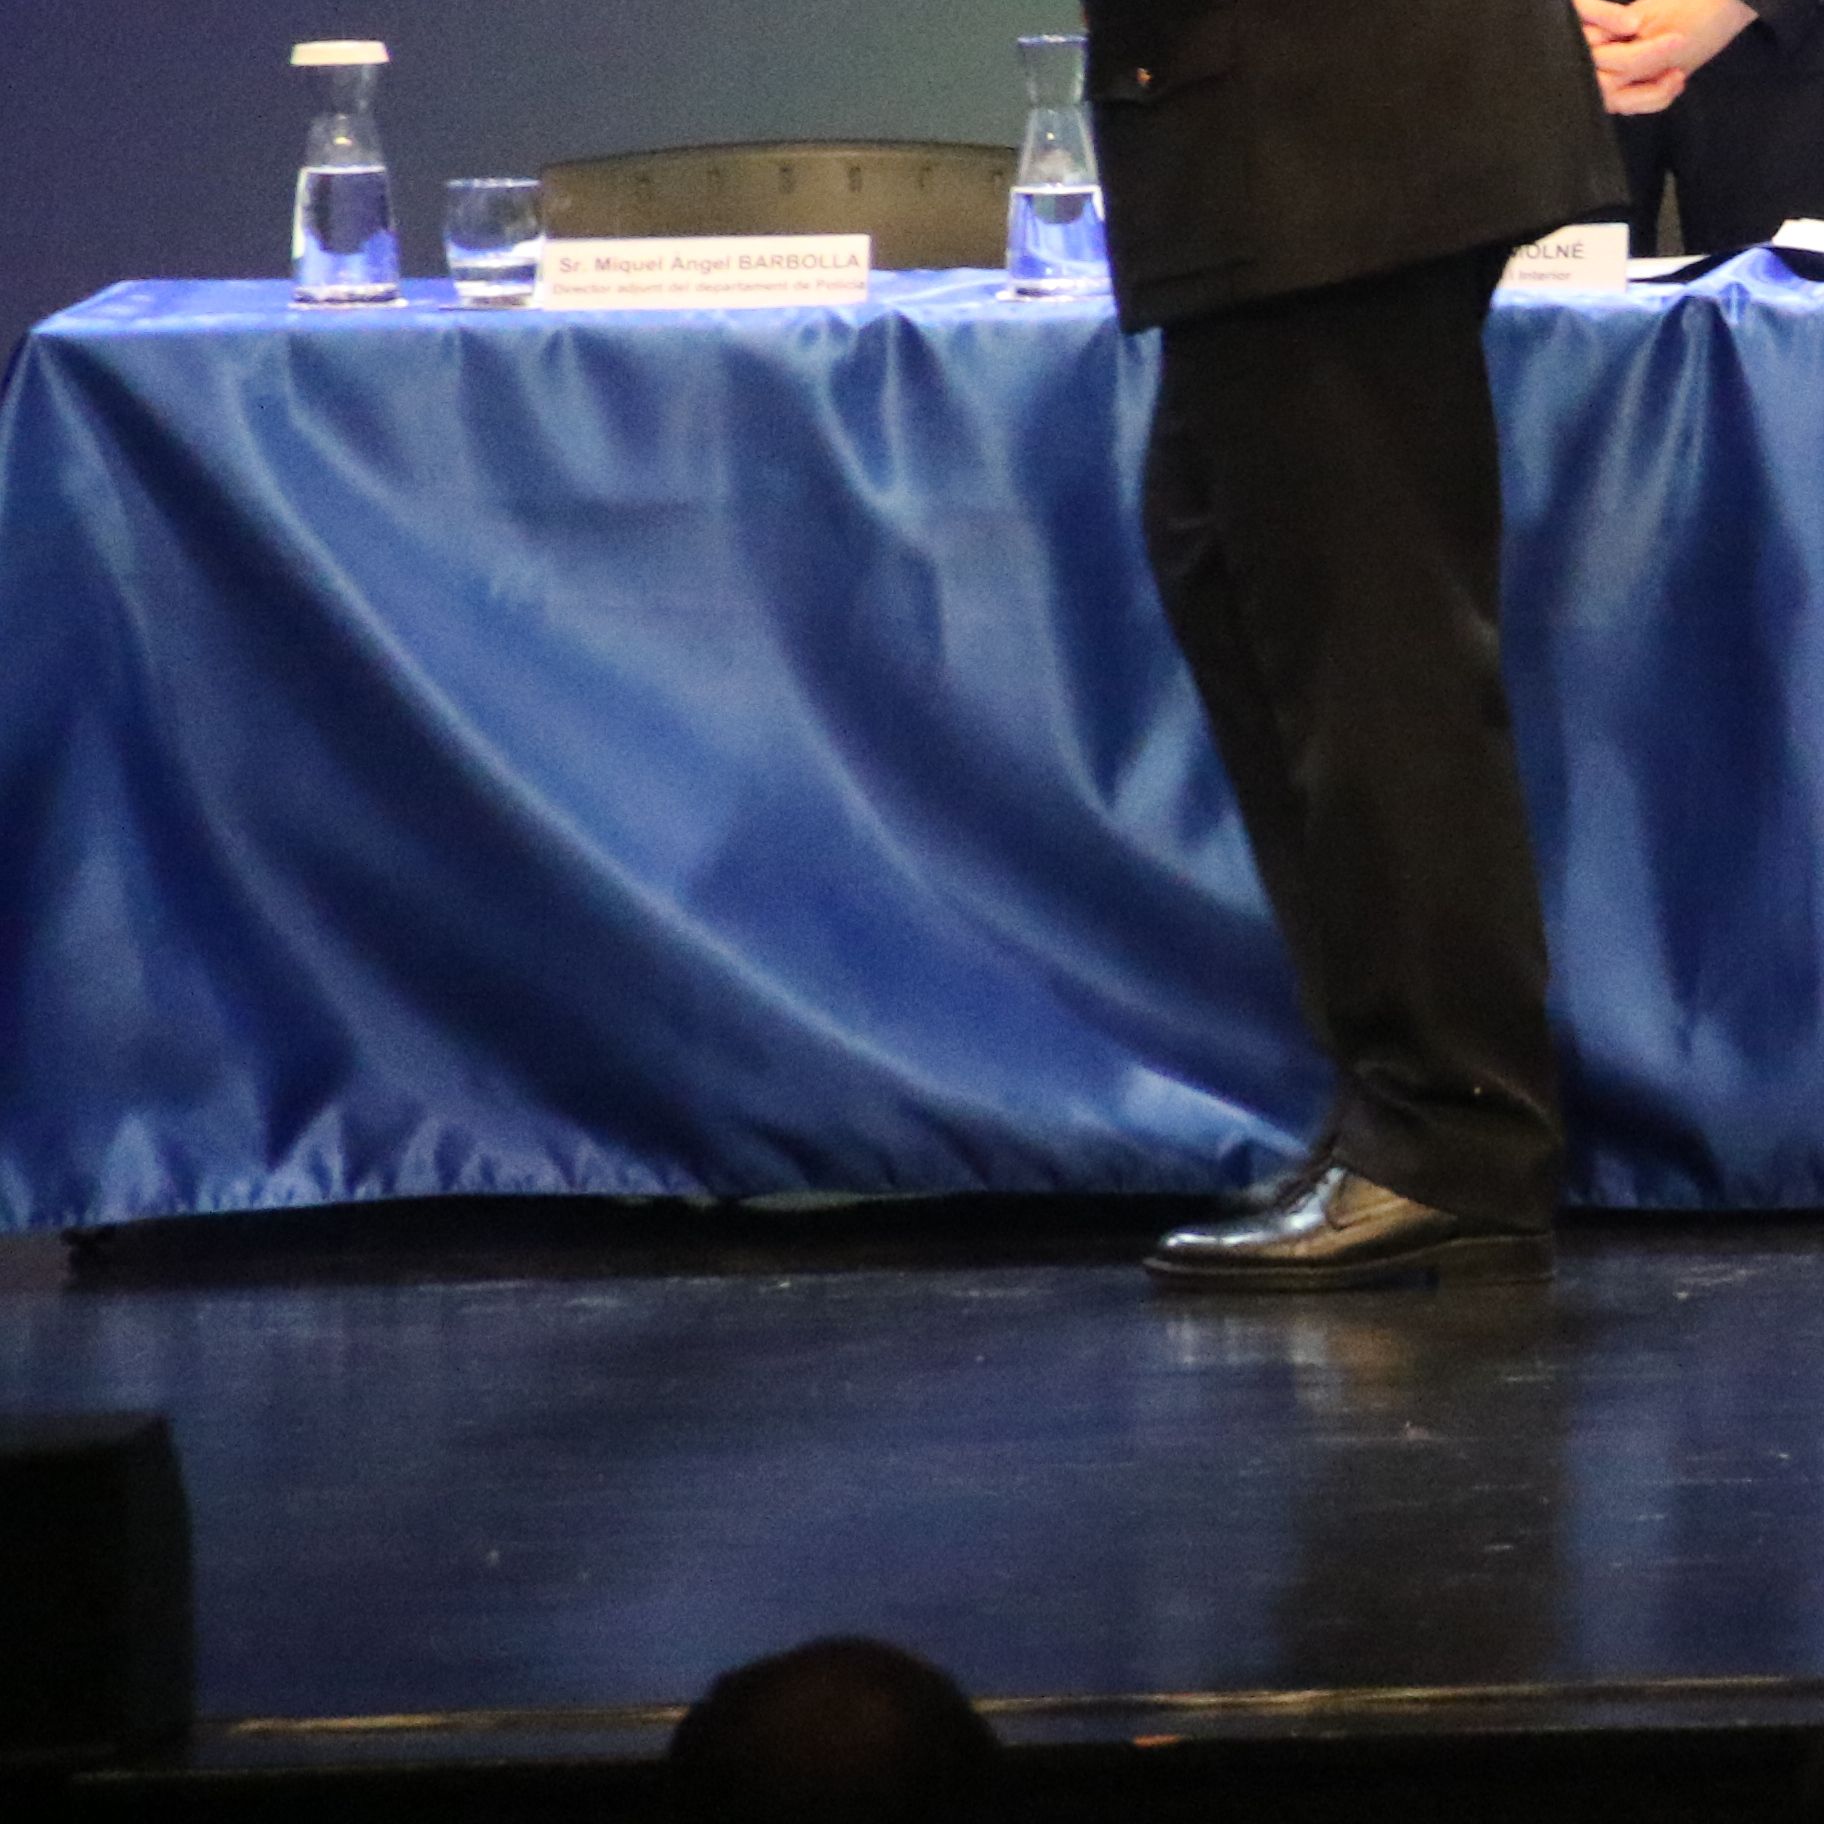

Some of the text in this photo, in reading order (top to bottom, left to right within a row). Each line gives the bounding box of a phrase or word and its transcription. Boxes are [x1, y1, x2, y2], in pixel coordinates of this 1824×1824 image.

[559, 257, 587, 273] Sr.
[594, 256, 663, 274] Miquel
[738, 254, 861, 271] BARBOLLA
